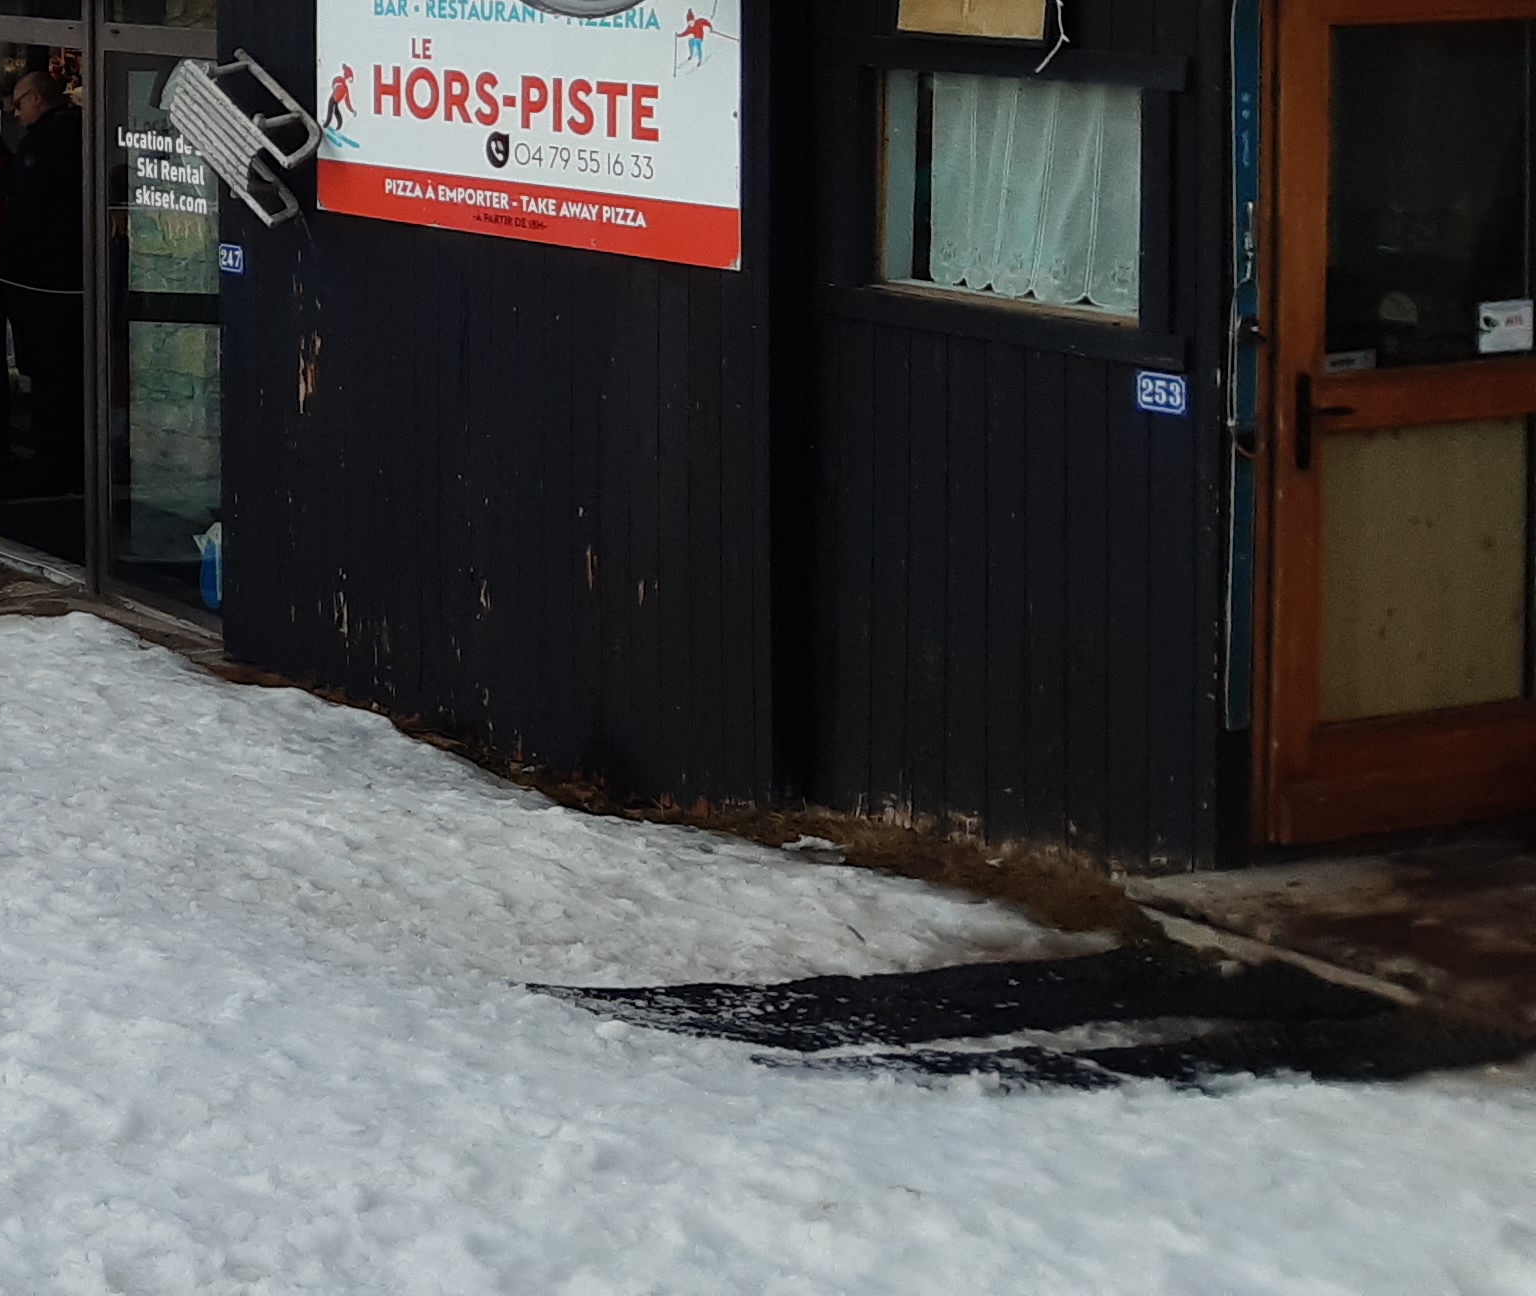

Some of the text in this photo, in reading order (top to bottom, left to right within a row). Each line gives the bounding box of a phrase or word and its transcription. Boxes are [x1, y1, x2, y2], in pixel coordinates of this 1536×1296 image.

[411, 38, 432, 60] LE
[373, 64, 660, 143] HORS-PISTE
[117, 126, 173, 153] Location
[137, 157, 205, 186] Ski Rental
[514, 143, 655, 180] 04 79 55 16 33
[135, 185, 208, 215] skiset.com
[384, 178, 424, 199] PIZZA
[425, 180, 436, 200] À
[438, 185, 510, 210] EMPORTER
[520, 195, 557, 216] TAKE
[559, 201, 600, 221] AWAY
[602, 206, 648, 228] PIZZA
[221, 249, 242, 268] 247
[1141, 378, 1182, 405] 253
